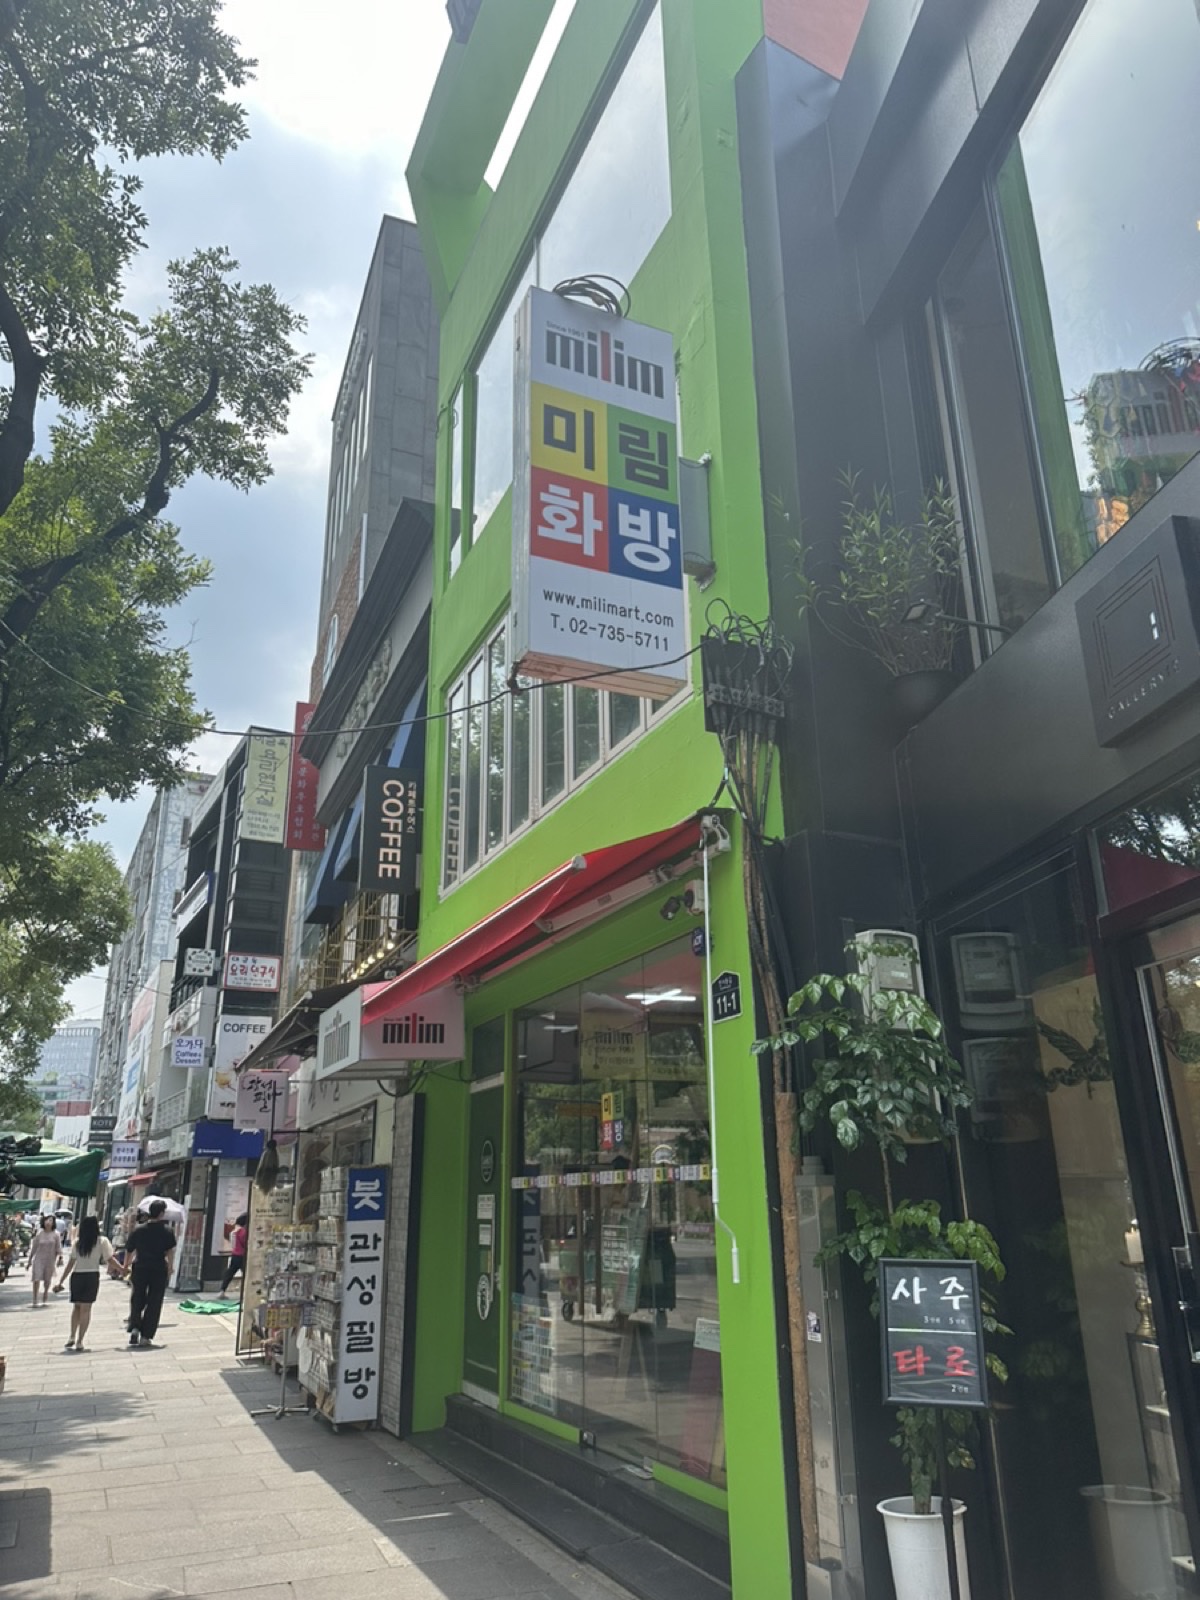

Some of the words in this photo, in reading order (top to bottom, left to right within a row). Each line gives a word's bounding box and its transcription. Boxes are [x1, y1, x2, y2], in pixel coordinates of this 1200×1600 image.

[546, 329, 664, 399] milim
[543, 403, 669, 491] 미림
[537, 484, 676, 572] 화방
[543, 588, 674, 627] www.milimart.com
[569, 618, 669, 651] 02-735-5711
[378, 779, 405, 879] COFFEE
[717, 992, 737, 1015] 11-1
[223, 1022, 267, 1034] COFFEE
[382, 1012, 444, 1044] milim
[351, 1178, 383, 1211] 붓
[891, 1276, 969, 1310] 사주
[343, 1231, 382, 1400] 관성필방
[892, 1345, 976, 1377] 타로
